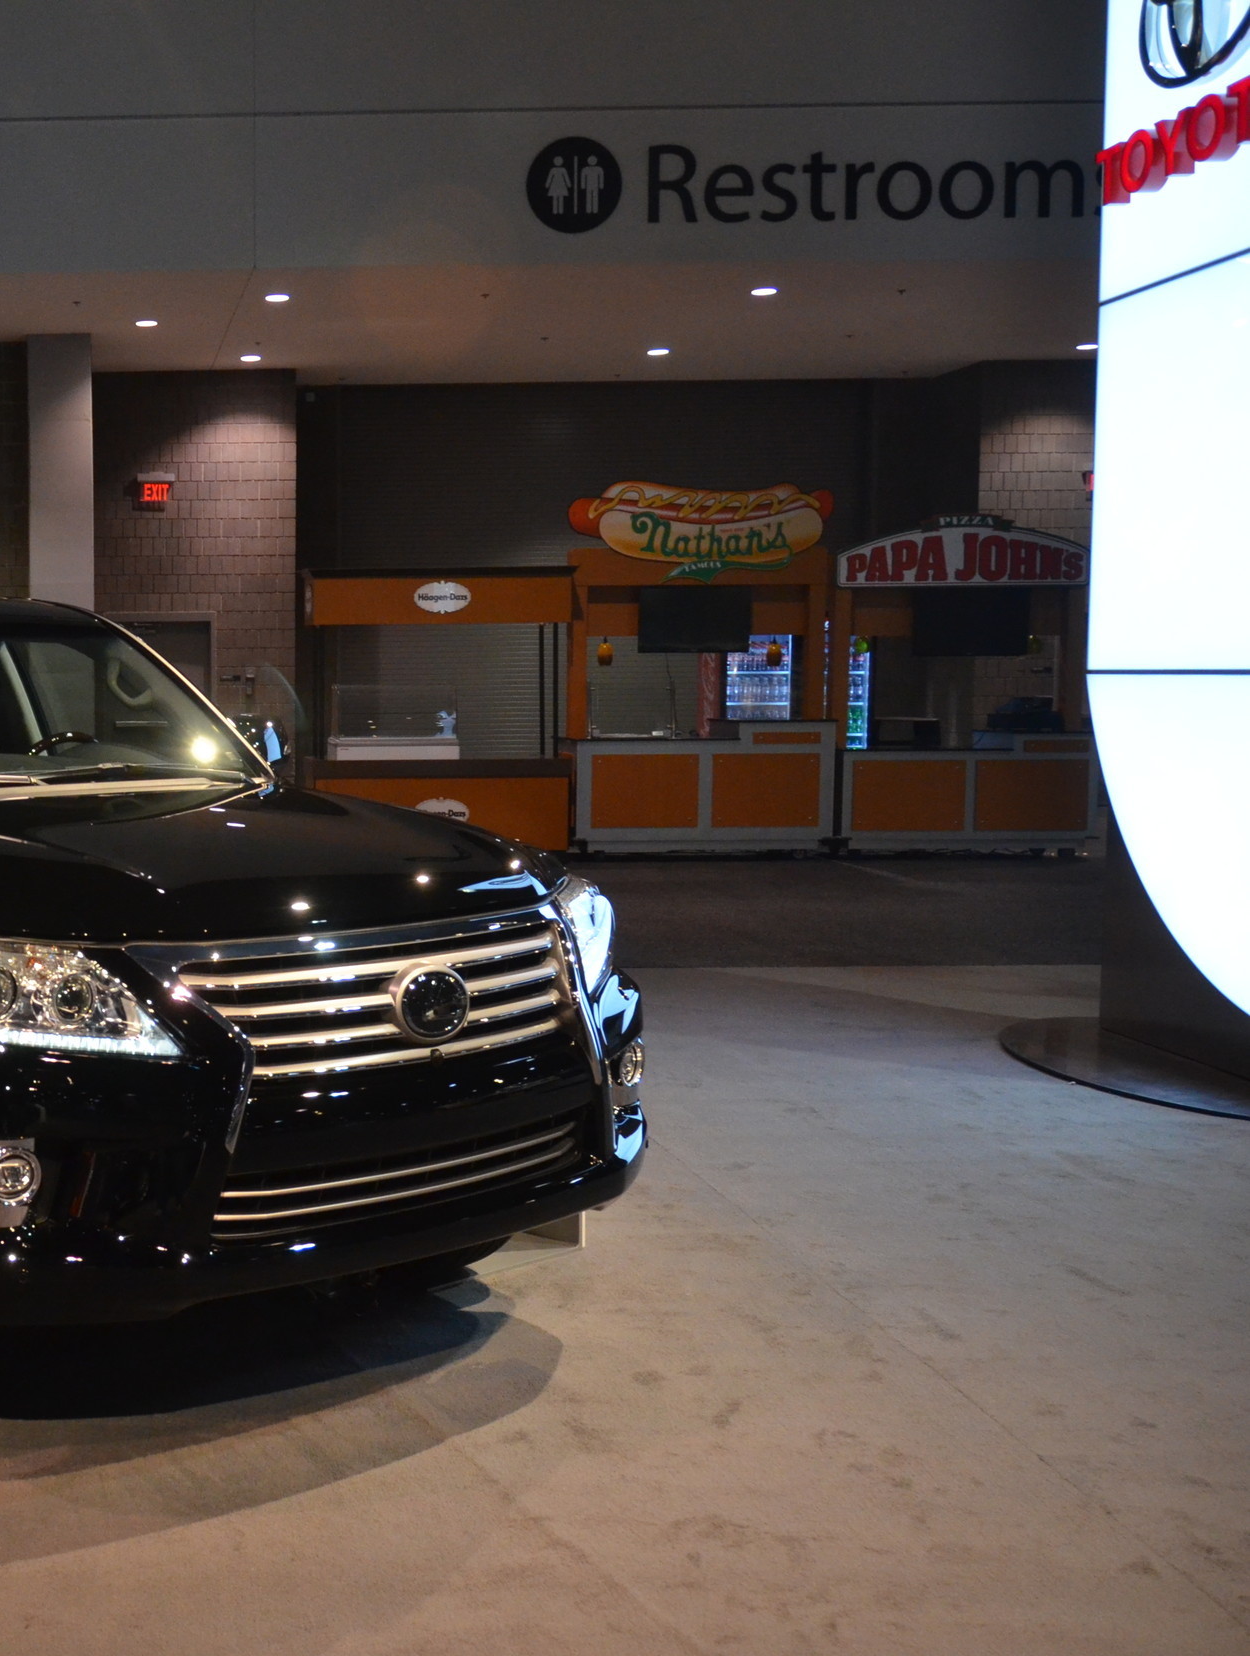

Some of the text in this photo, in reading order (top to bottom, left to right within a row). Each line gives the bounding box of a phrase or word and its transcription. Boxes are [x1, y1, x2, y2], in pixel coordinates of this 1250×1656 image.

[646, 144, 1103, 223] Restroom
[143, 483, 170, 501] EXIT
[630, 511, 792, 560] Nathan's
[939, 516, 994, 526] PIZZA
[846, 535, 948, 582] PAPA
